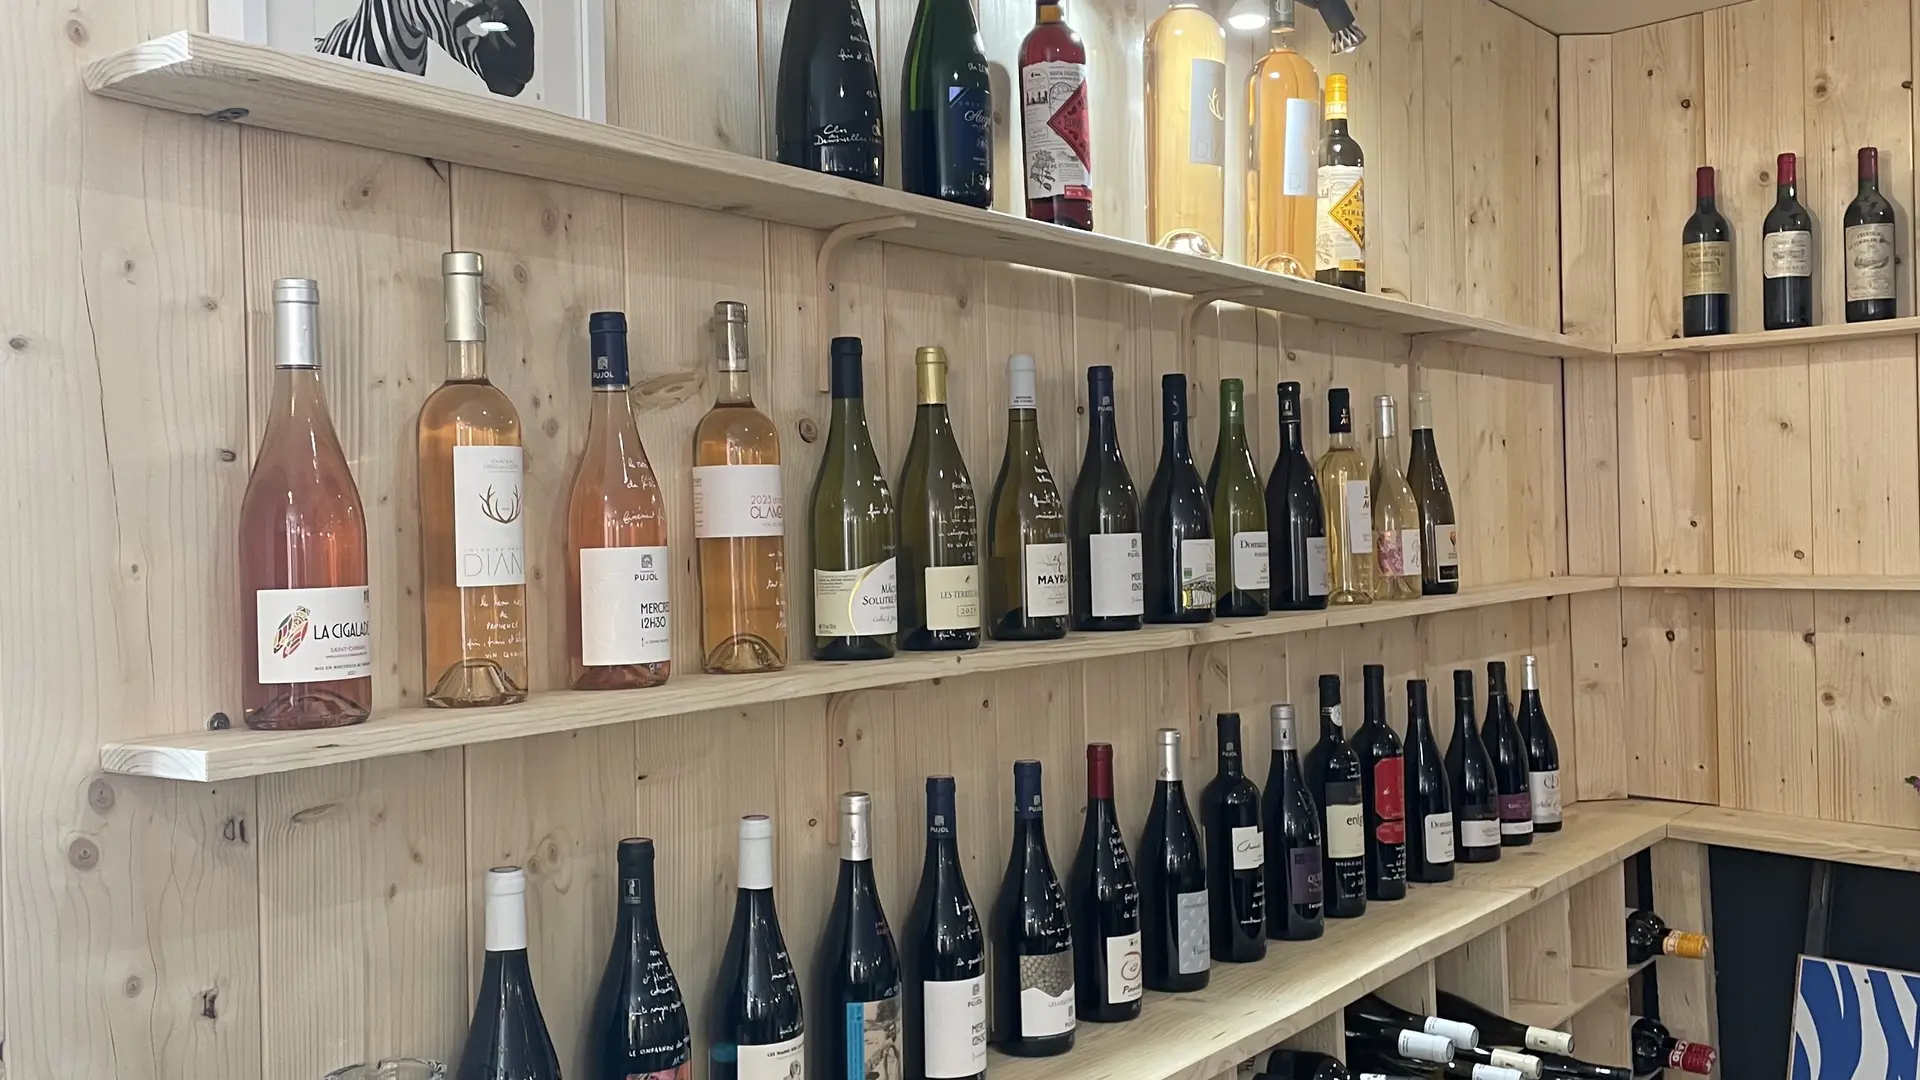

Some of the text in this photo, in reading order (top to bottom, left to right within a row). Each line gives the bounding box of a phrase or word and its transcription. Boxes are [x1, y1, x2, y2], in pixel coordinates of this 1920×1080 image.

[634, 573, 658, 581] PUJOL
[641, 617, 666, 628] 12H30
[314, 624, 329, 640] LA
[930, 824, 949, 833] PUJOL
